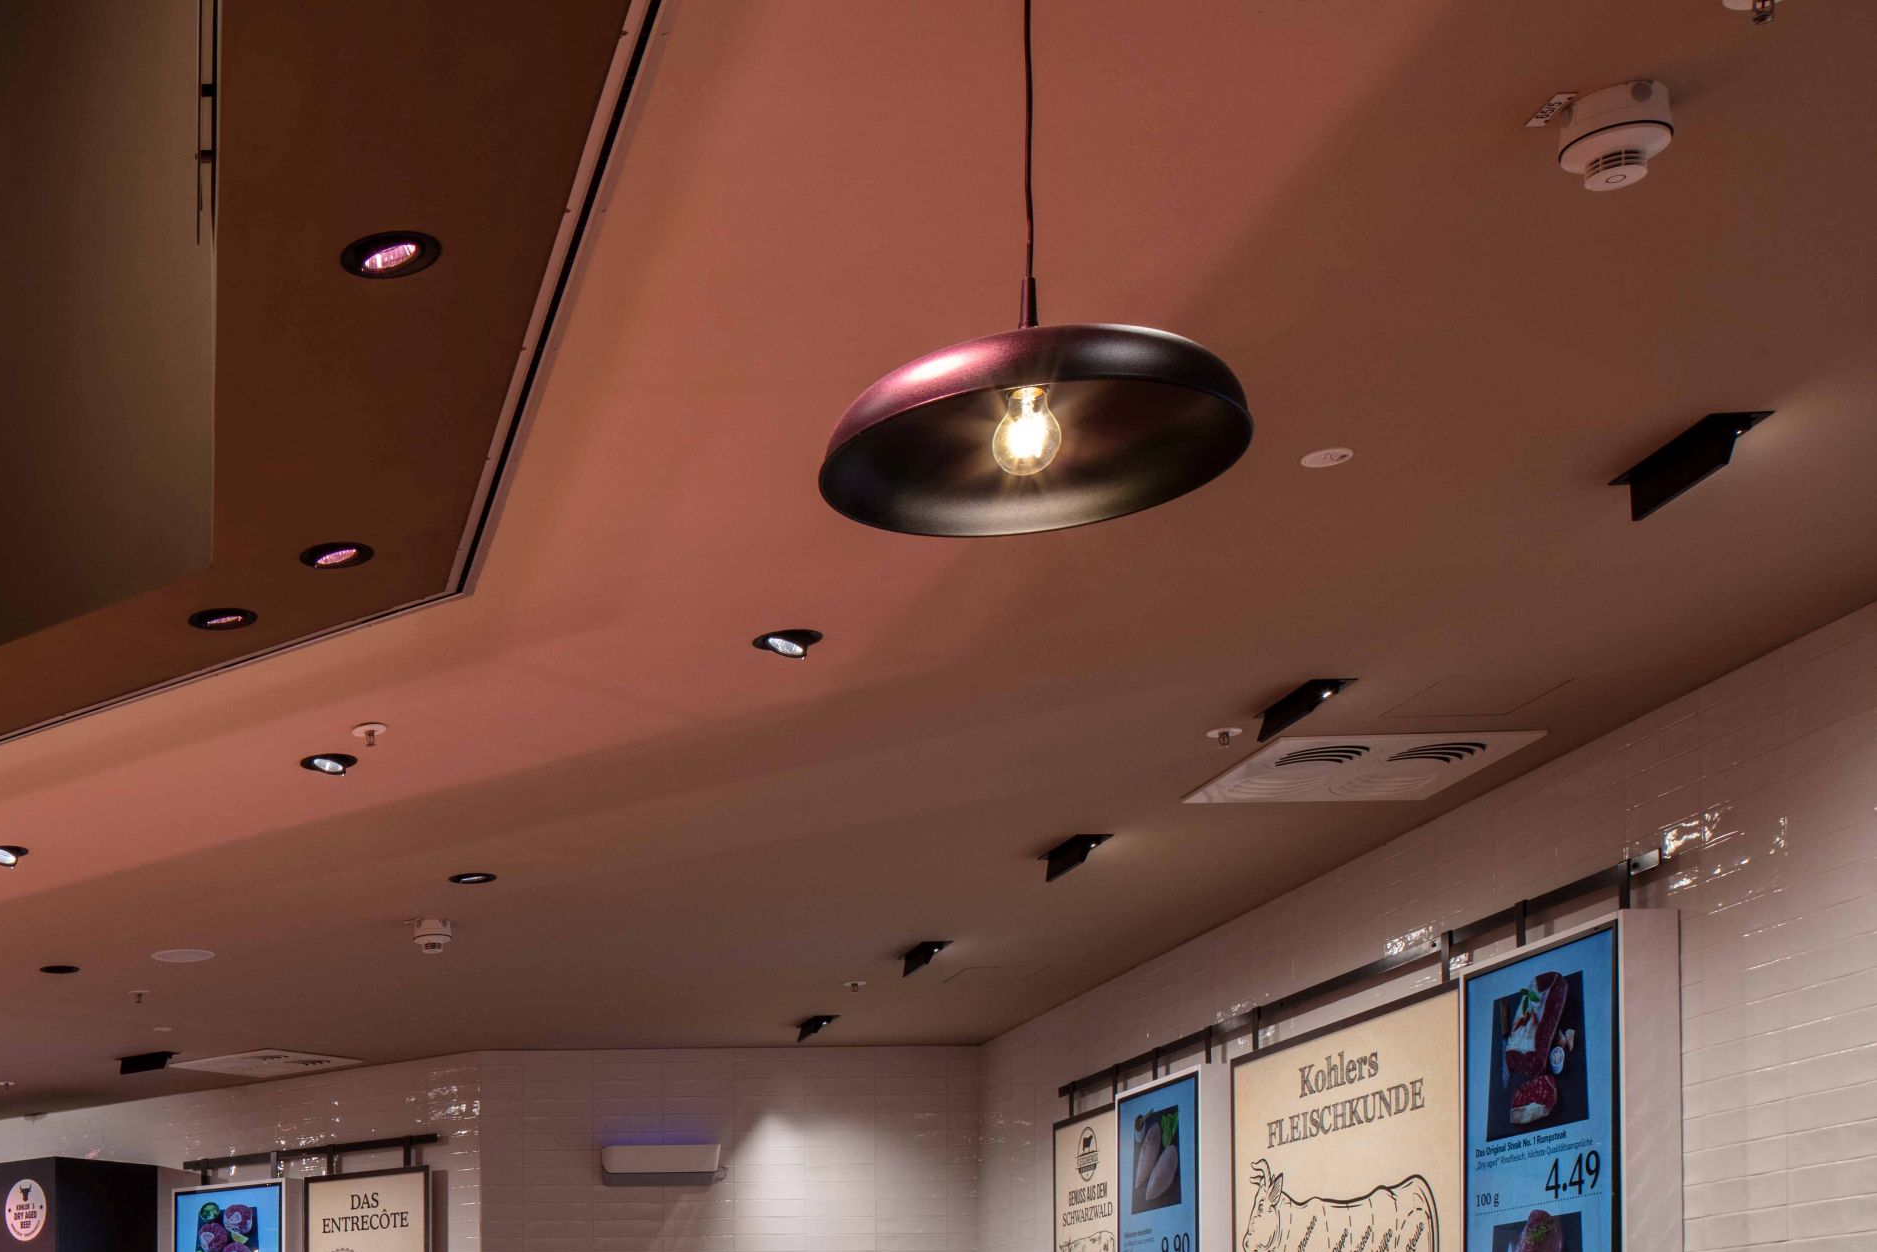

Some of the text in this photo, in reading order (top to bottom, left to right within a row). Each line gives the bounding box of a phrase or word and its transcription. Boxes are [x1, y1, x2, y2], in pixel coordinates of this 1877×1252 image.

[1298, 1051, 1379, 1099] Kohlers
[1267, 1077, 1425, 1149] FLEISCHKUNDE
[1476, 1149, 1485, 1158] Das
[1486, 1143, 1507, 1157] Original
[1507, 1139, 1522, 1151] Steak
[1545, 1150, 1600, 1199] 4.49
[351, 1192, 379, 1210] DAS
[1068, 1181, 1108, 1206] GENUSS AUS DEM
[1476, 1193, 1500, 1208] 100 g
[322, 1209, 409, 1234] ENTRECÔTE
[1062, 1202, 1113, 1227] SCHWARZWALD
